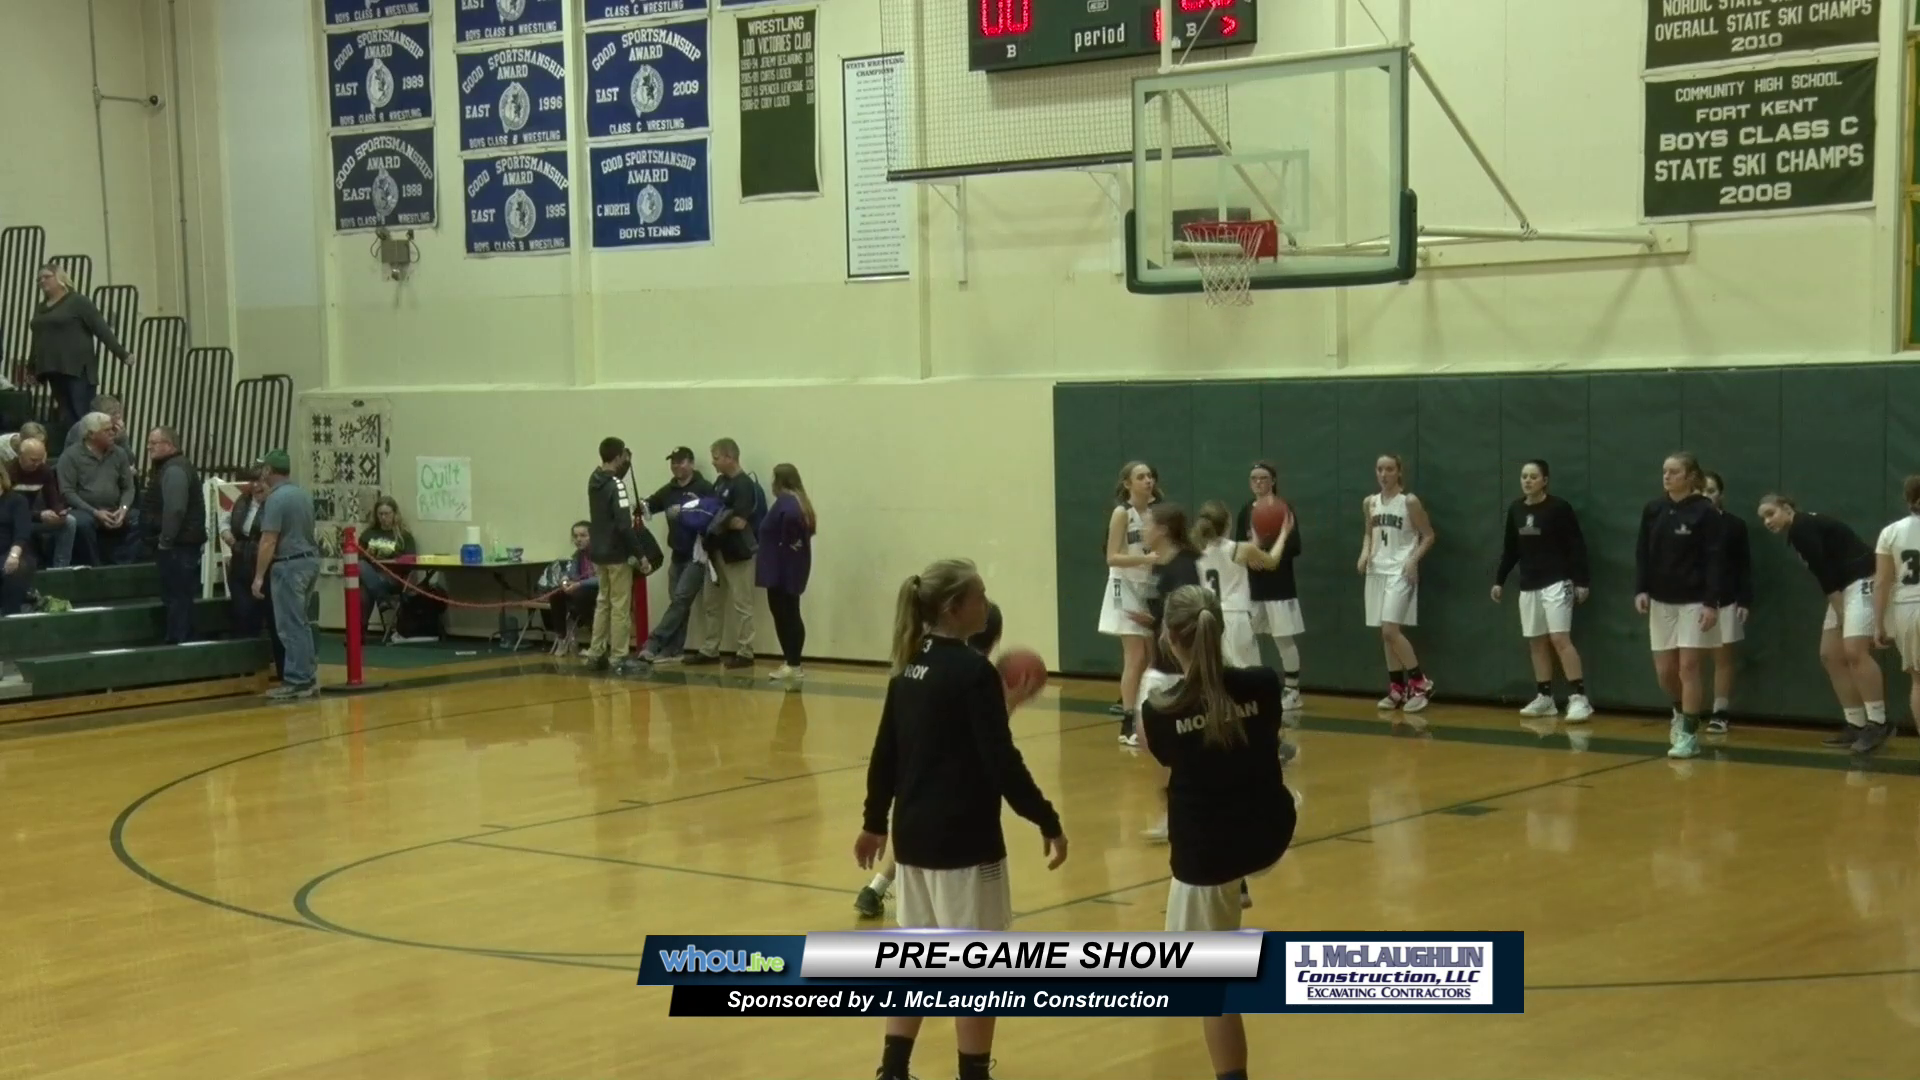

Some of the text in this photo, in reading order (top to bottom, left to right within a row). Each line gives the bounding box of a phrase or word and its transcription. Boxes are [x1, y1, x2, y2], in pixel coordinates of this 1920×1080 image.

[335, 12, 350, 23] BOYS
[354, 9, 372, 20] CLASS
[385, 3, 419, 16] WRESTLING
[605, 0, 684, 18] CLASS C WRESTLING
[1663, 0, 1712, 17] NORDIC
[465, 29, 481, 40] BOYS
[484, 26, 506, 38] CLASS
[519, 21, 557, 34] WRESTLING
[748, 16, 804, 36] WRESTLING
[1186, 22, 1197, 37] B
[1655, 0, 1872, 42] OVERALL STATE SKI CHAMPS
[743, 32, 811, 56] 100 VICTORIES CLUB
[1074, 22, 1125, 53] period
[1731, 32, 1782, 52] 2010
[334, 30, 424, 71] GOOD SPORTSMANSHIP
[364, 44, 392, 60] AWARD
[592, 28, 701, 71] GOOD SPORTSMANSHIP
[629, 44, 663, 61] AWARD
[1006, 44, 1017, 58] B
[462, 49, 566, 94] GOOD SPORTSMANSHIP
[497, 64, 528, 80] AWARD
[335, 82, 358, 96] EAST
[595, 79, 699, 103] EAST 2009
[1675, 71, 1843, 103] COMMUNITY HIGH SCHOOL
[358, 113, 376, 124] CLASS
[389, 108, 422, 121] WRESTLING
[465, 95, 563, 119] EAST 1996
[1696, 97, 1819, 123] FORT KENT
[609, 117, 684, 135] CLASS C WRESTLING
[1659, 116, 1859, 153] BOYS CLASS C
[469, 137, 486, 149] BOYS
[487, 135, 508, 147] CLASS
[522, 130, 560, 143] WRESTLING
[336, 136, 434, 190] GOOD SPORTSMANSHIP
[366, 156, 401, 171] AWARD
[600, 149, 696, 174] GOOD SPORTSMANSHIP
[1654, 143, 1864, 182] STATE SKI CHAMPS
[467, 155, 569, 198] GOOD SPORTSMANSHIP
[502, 171, 534, 186] AWARD
[627, 168, 669, 185] AWARD
[342, 187, 372, 202] EAST
[1719, 181, 1792, 205] 2008
[357, 215, 377, 226] CLASS
[398, 212, 430, 223] WRESTLING
[471, 208, 496, 223] EAST
[597, 205, 602, 217] C
[604, 203, 630, 216] NORTH
[619, 225, 681, 240] BOYS TENNIS
[473, 241, 490, 252] BOYS
[494, 240, 515, 251] CLASS
[529, 237, 564, 250] WRESTLING
[421, 463, 460, 490] Quilt
[1381, 529, 1388, 547] 4
